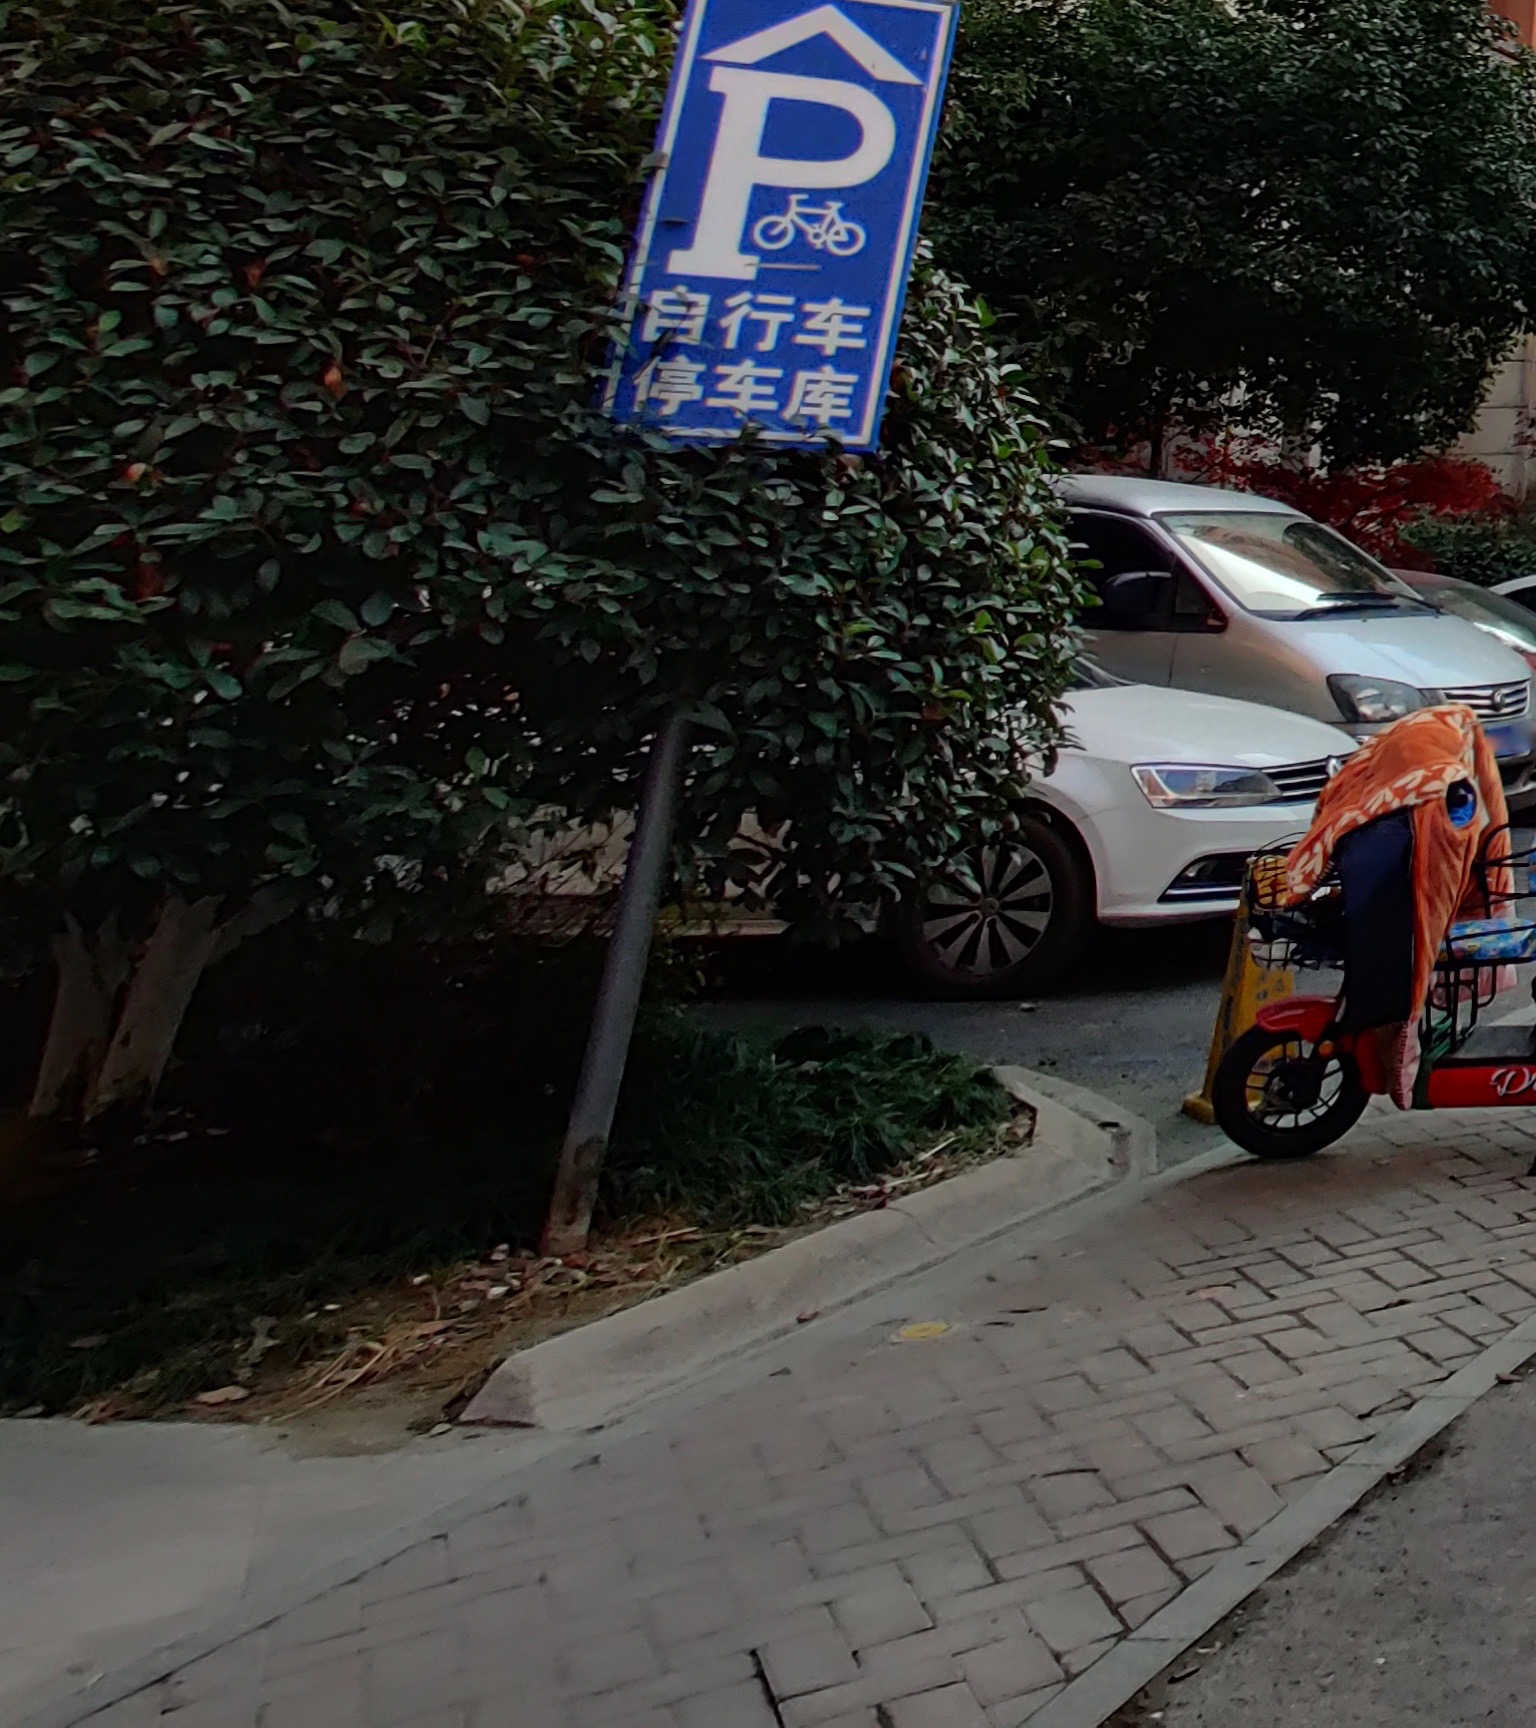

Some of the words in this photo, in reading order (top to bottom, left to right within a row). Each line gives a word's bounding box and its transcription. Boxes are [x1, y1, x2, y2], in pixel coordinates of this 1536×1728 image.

[667, 66, 897, 280] P
[641, 285, 871, 355] 自行车
[634, 354, 859, 422] 停车库
